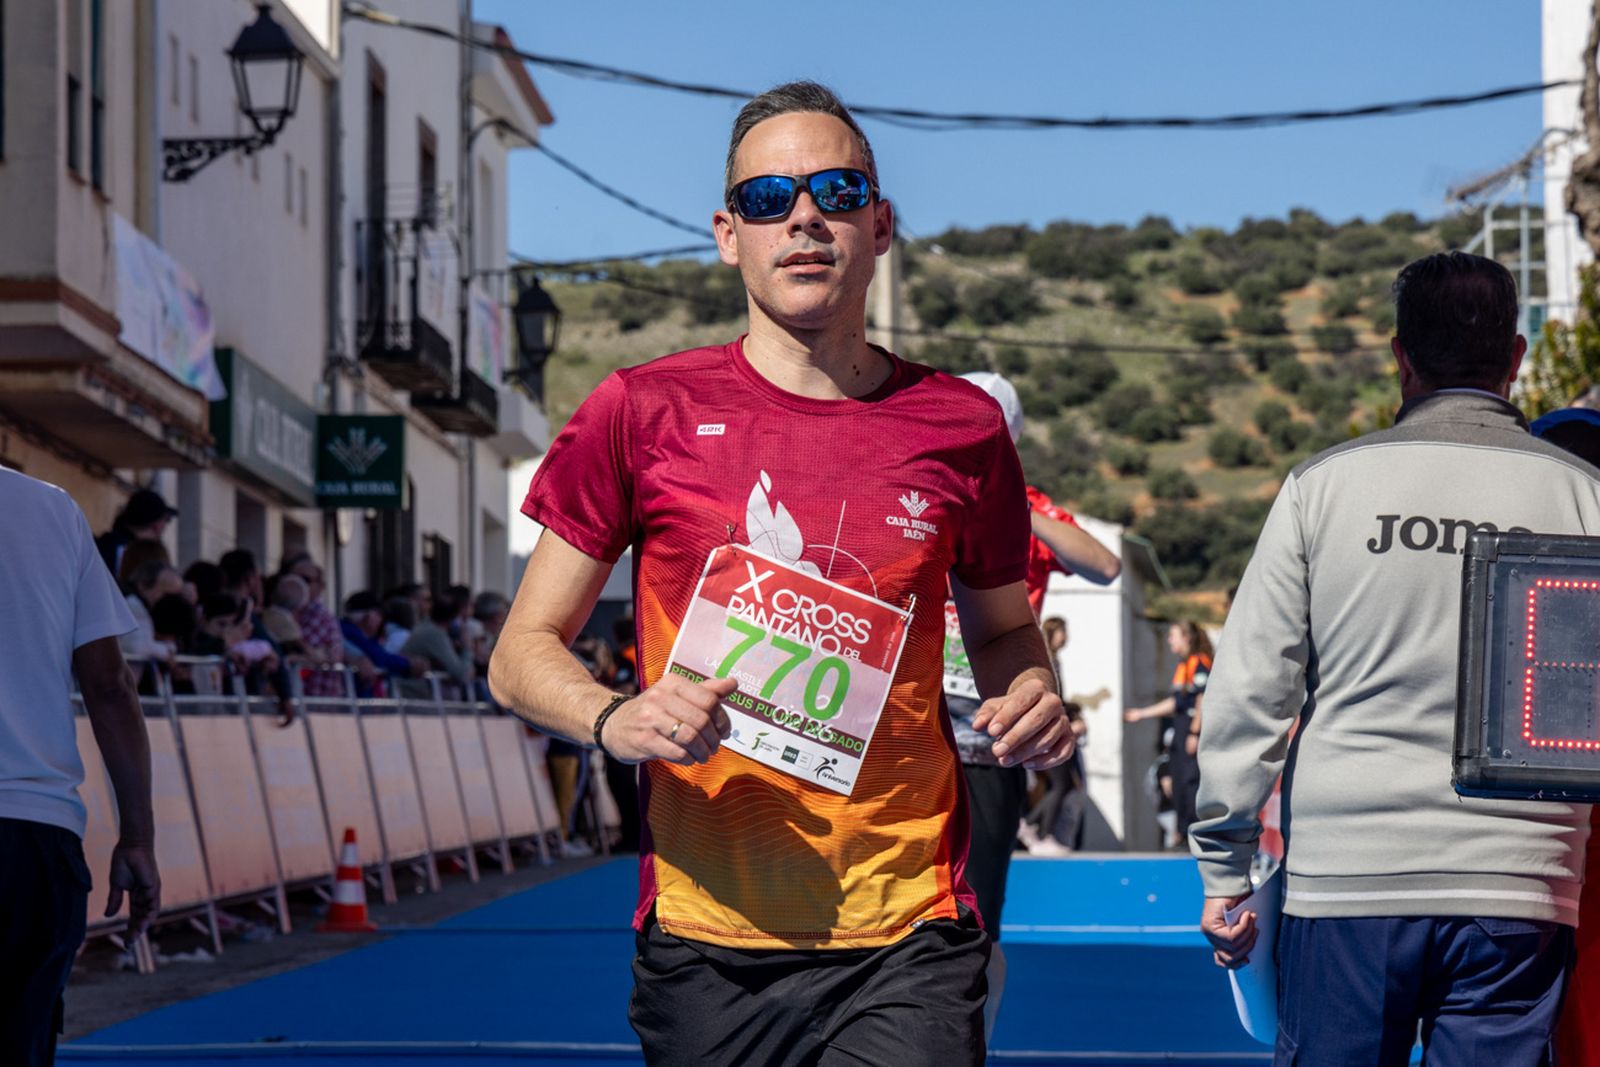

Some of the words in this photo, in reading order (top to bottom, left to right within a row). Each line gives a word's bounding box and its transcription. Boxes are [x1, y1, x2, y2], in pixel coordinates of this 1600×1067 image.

[886, 516, 910, 527] CAJA
[911, 519, 938, 535] RURAL
[1367, 514, 1533, 554] Jom
[725, 595, 842, 657] PANTANO
[843, 646, 862, 662] DEL
[735, 560, 775, 604] X
[772, 589, 872, 644] CROSS
[671, 665, 704, 684] PEDR
[715, 615, 851, 721] 770
